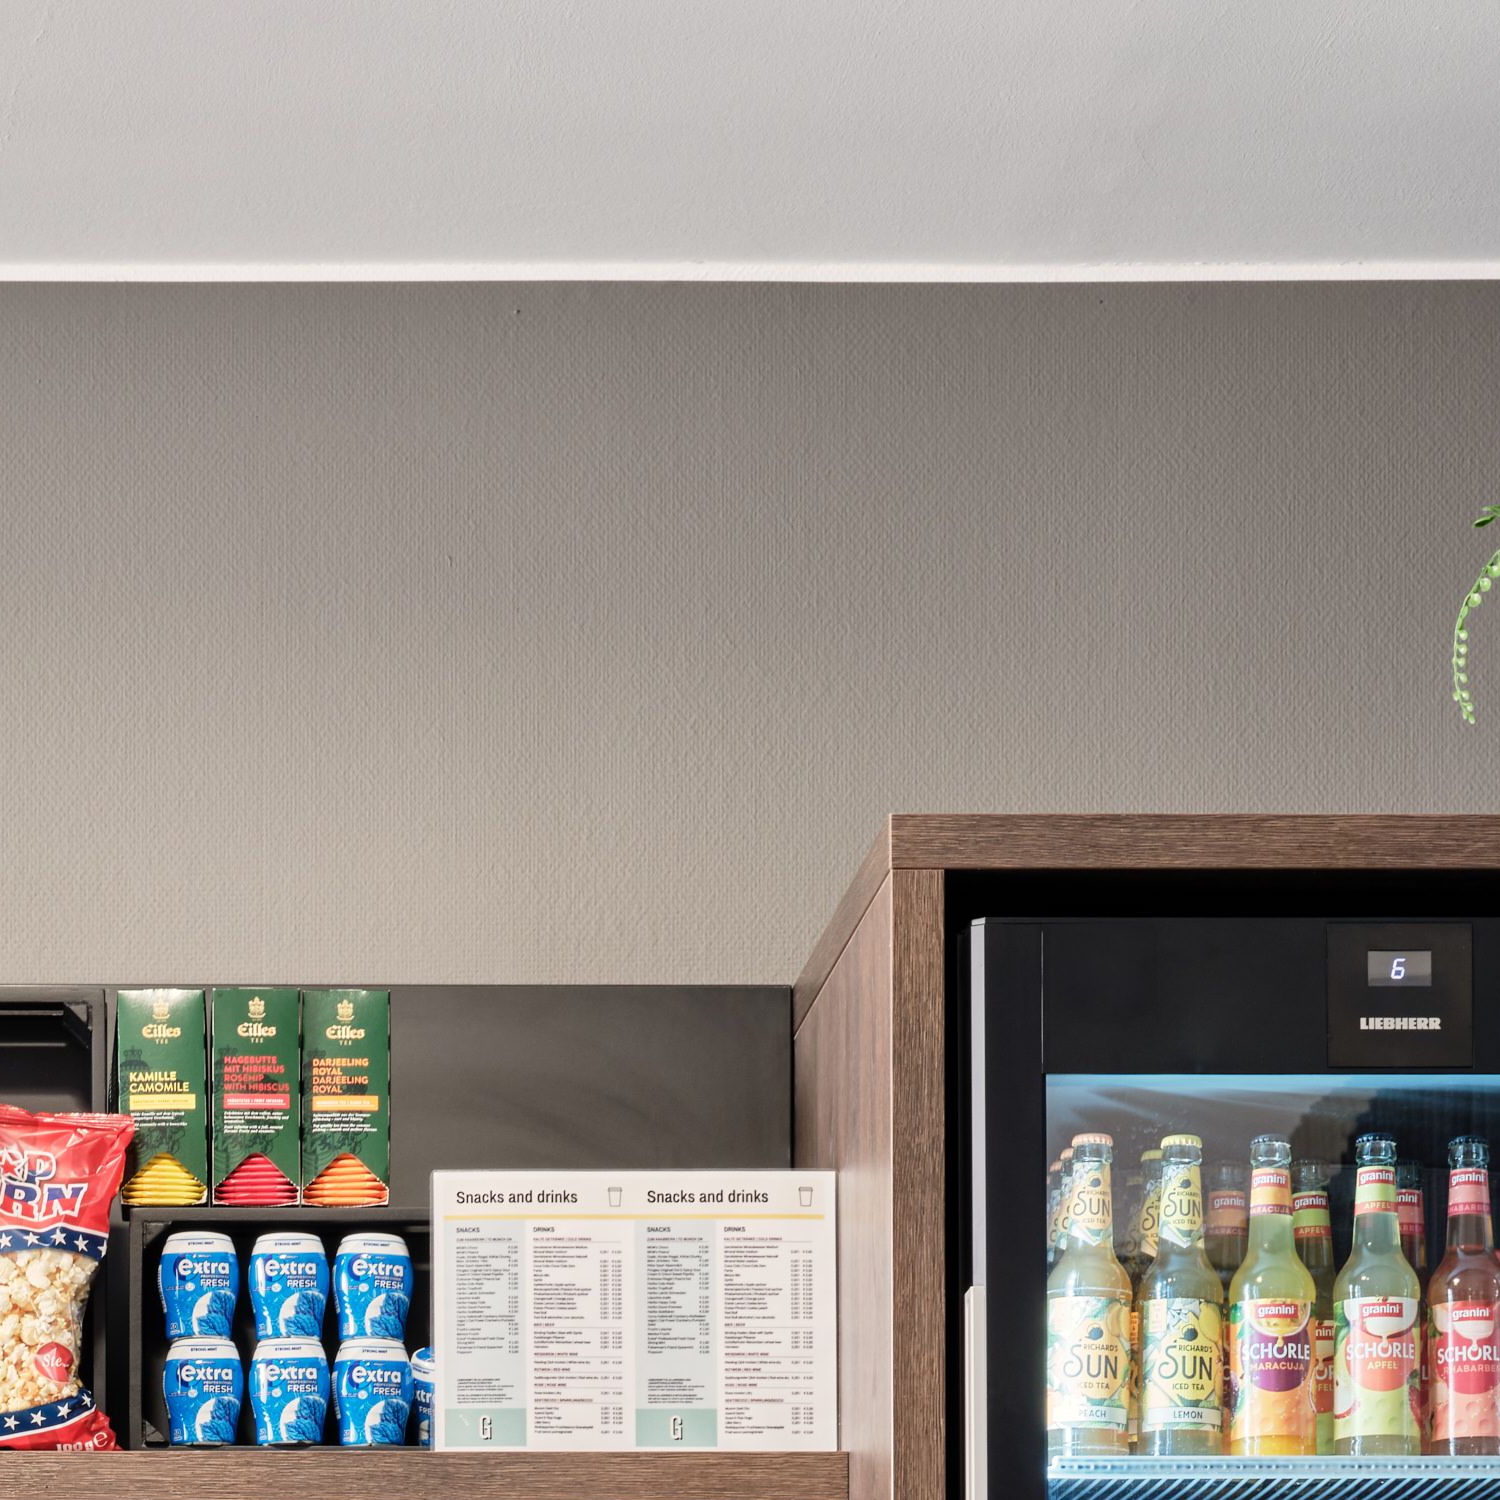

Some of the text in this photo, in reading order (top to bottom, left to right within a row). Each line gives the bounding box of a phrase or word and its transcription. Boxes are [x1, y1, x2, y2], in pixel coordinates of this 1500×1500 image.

[1390, 958, 1406, 980] 6
[236, 1021, 277, 1038] Eilles
[1360, 1017, 1442, 1030] LIEBHERR
[141, 1022, 182, 1039] Eilles
[325, 1024, 366, 1040] Eilles
[242, 1064, 285, 1073] HIBISKUS
[312, 1057, 369, 1067] DARJEELING
[129, 1070, 177, 1082] KAMILLE
[223, 1073, 265, 1082] ROSEHIP
[312, 1067, 343, 1076] ROYAL
[129, 1081, 190, 1093] CAMOMILE
[248, 1082, 290, 1092] HIBISCUS
[312, 1076, 369, 1085] DARJEELING
[312, 1085, 343, 1094] ROYAL
[1252, 1174, 1286, 1187] granini
[1360, 1170, 1394, 1184] granini
[1451, 1172, 1485, 1186] granini
[456, 1190, 578, 1204] Snacks and drinks
[646, 1189, 769, 1204] Snacks and drinks
[1163, 1191, 1201, 1218] SUN
[177, 1257, 230, 1276] extra
[264, 1258, 317, 1276] extra
[351, 1258, 404, 1277] extra
[200, 1279, 230, 1288] FRESH
[287, 1279, 317, 1288] FRESH
[374, 1280, 404, 1290] FRESH
[1258, 1305, 1295, 1317] granini
[1363, 1304, 1399, 1317] granini
[1452, 1308, 1490, 1320] granini
[1242, 1342, 1311, 1361] SCHORLE
[1346, 1343, 1415, 1360] SCHORLE
[1063, 1343, 1118, 1380] SUN
[1158, 1344, 1213, 1381] SUN
[1367, 1361, 1399, 1370] APFEL
[180, 1363, 233, 1382] extra
[265, 1364, 317, 1383] extra
[352, 1364, 401, 1384] extra
[203, 1384, 233, 1393] FRESH
[287, 1384, 318, 1393] FRESH
[373, 1386, 401, 1396] FRESH
[1192, 1383, 1205, 1391] TEA
[1173, 1410, 1204, 1420] LEMON
